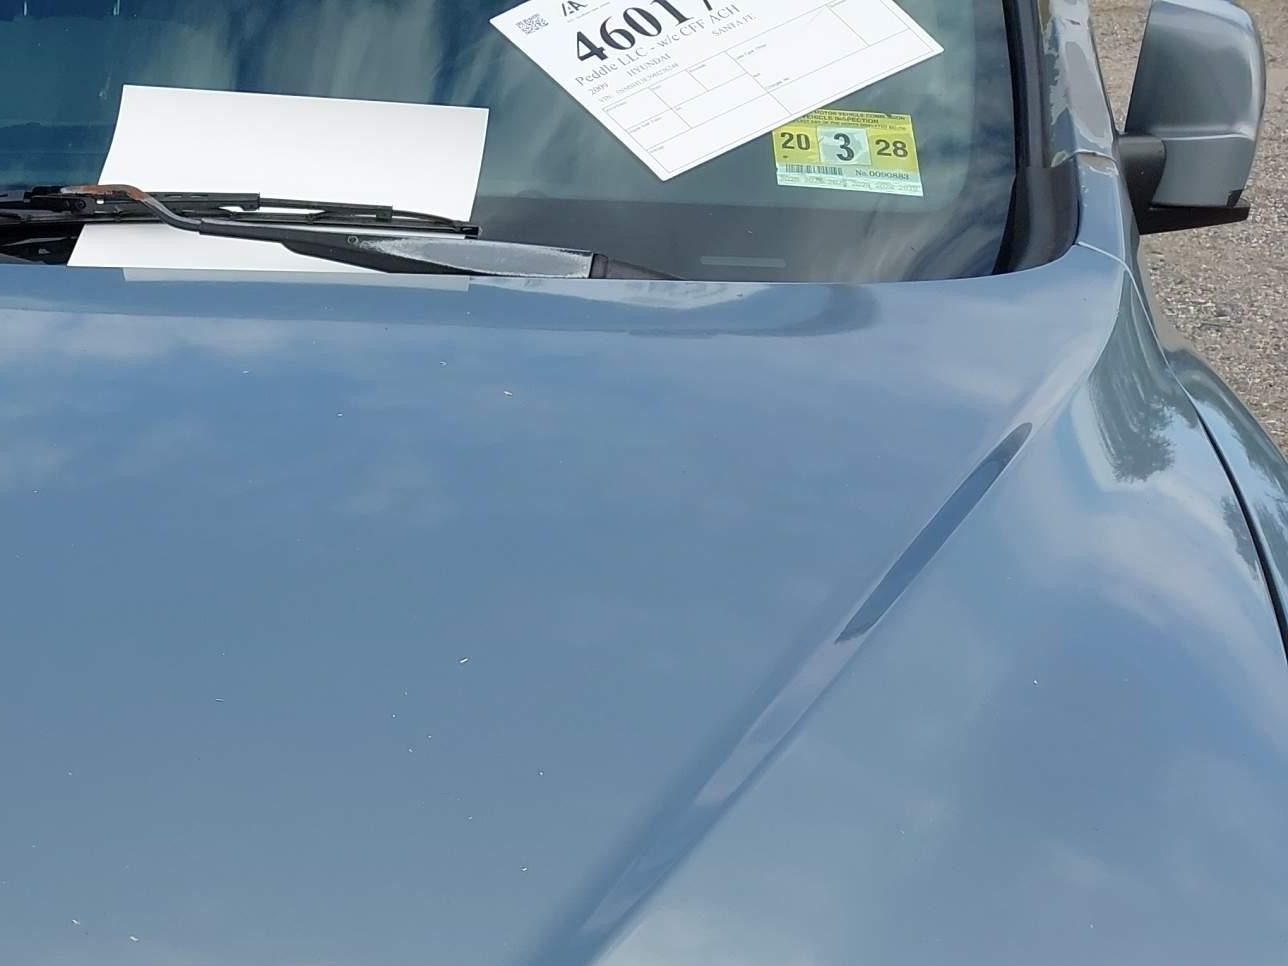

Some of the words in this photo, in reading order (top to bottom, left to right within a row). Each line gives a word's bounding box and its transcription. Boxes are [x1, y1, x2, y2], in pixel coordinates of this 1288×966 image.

[575, 63, 618, 86] Peddle
[626, 52, 671, 77] HYUNDAI
[780, 132, 810, 151] 20
[833, 133, 855, 161] 3
[875, 139, 908, 158] 28
